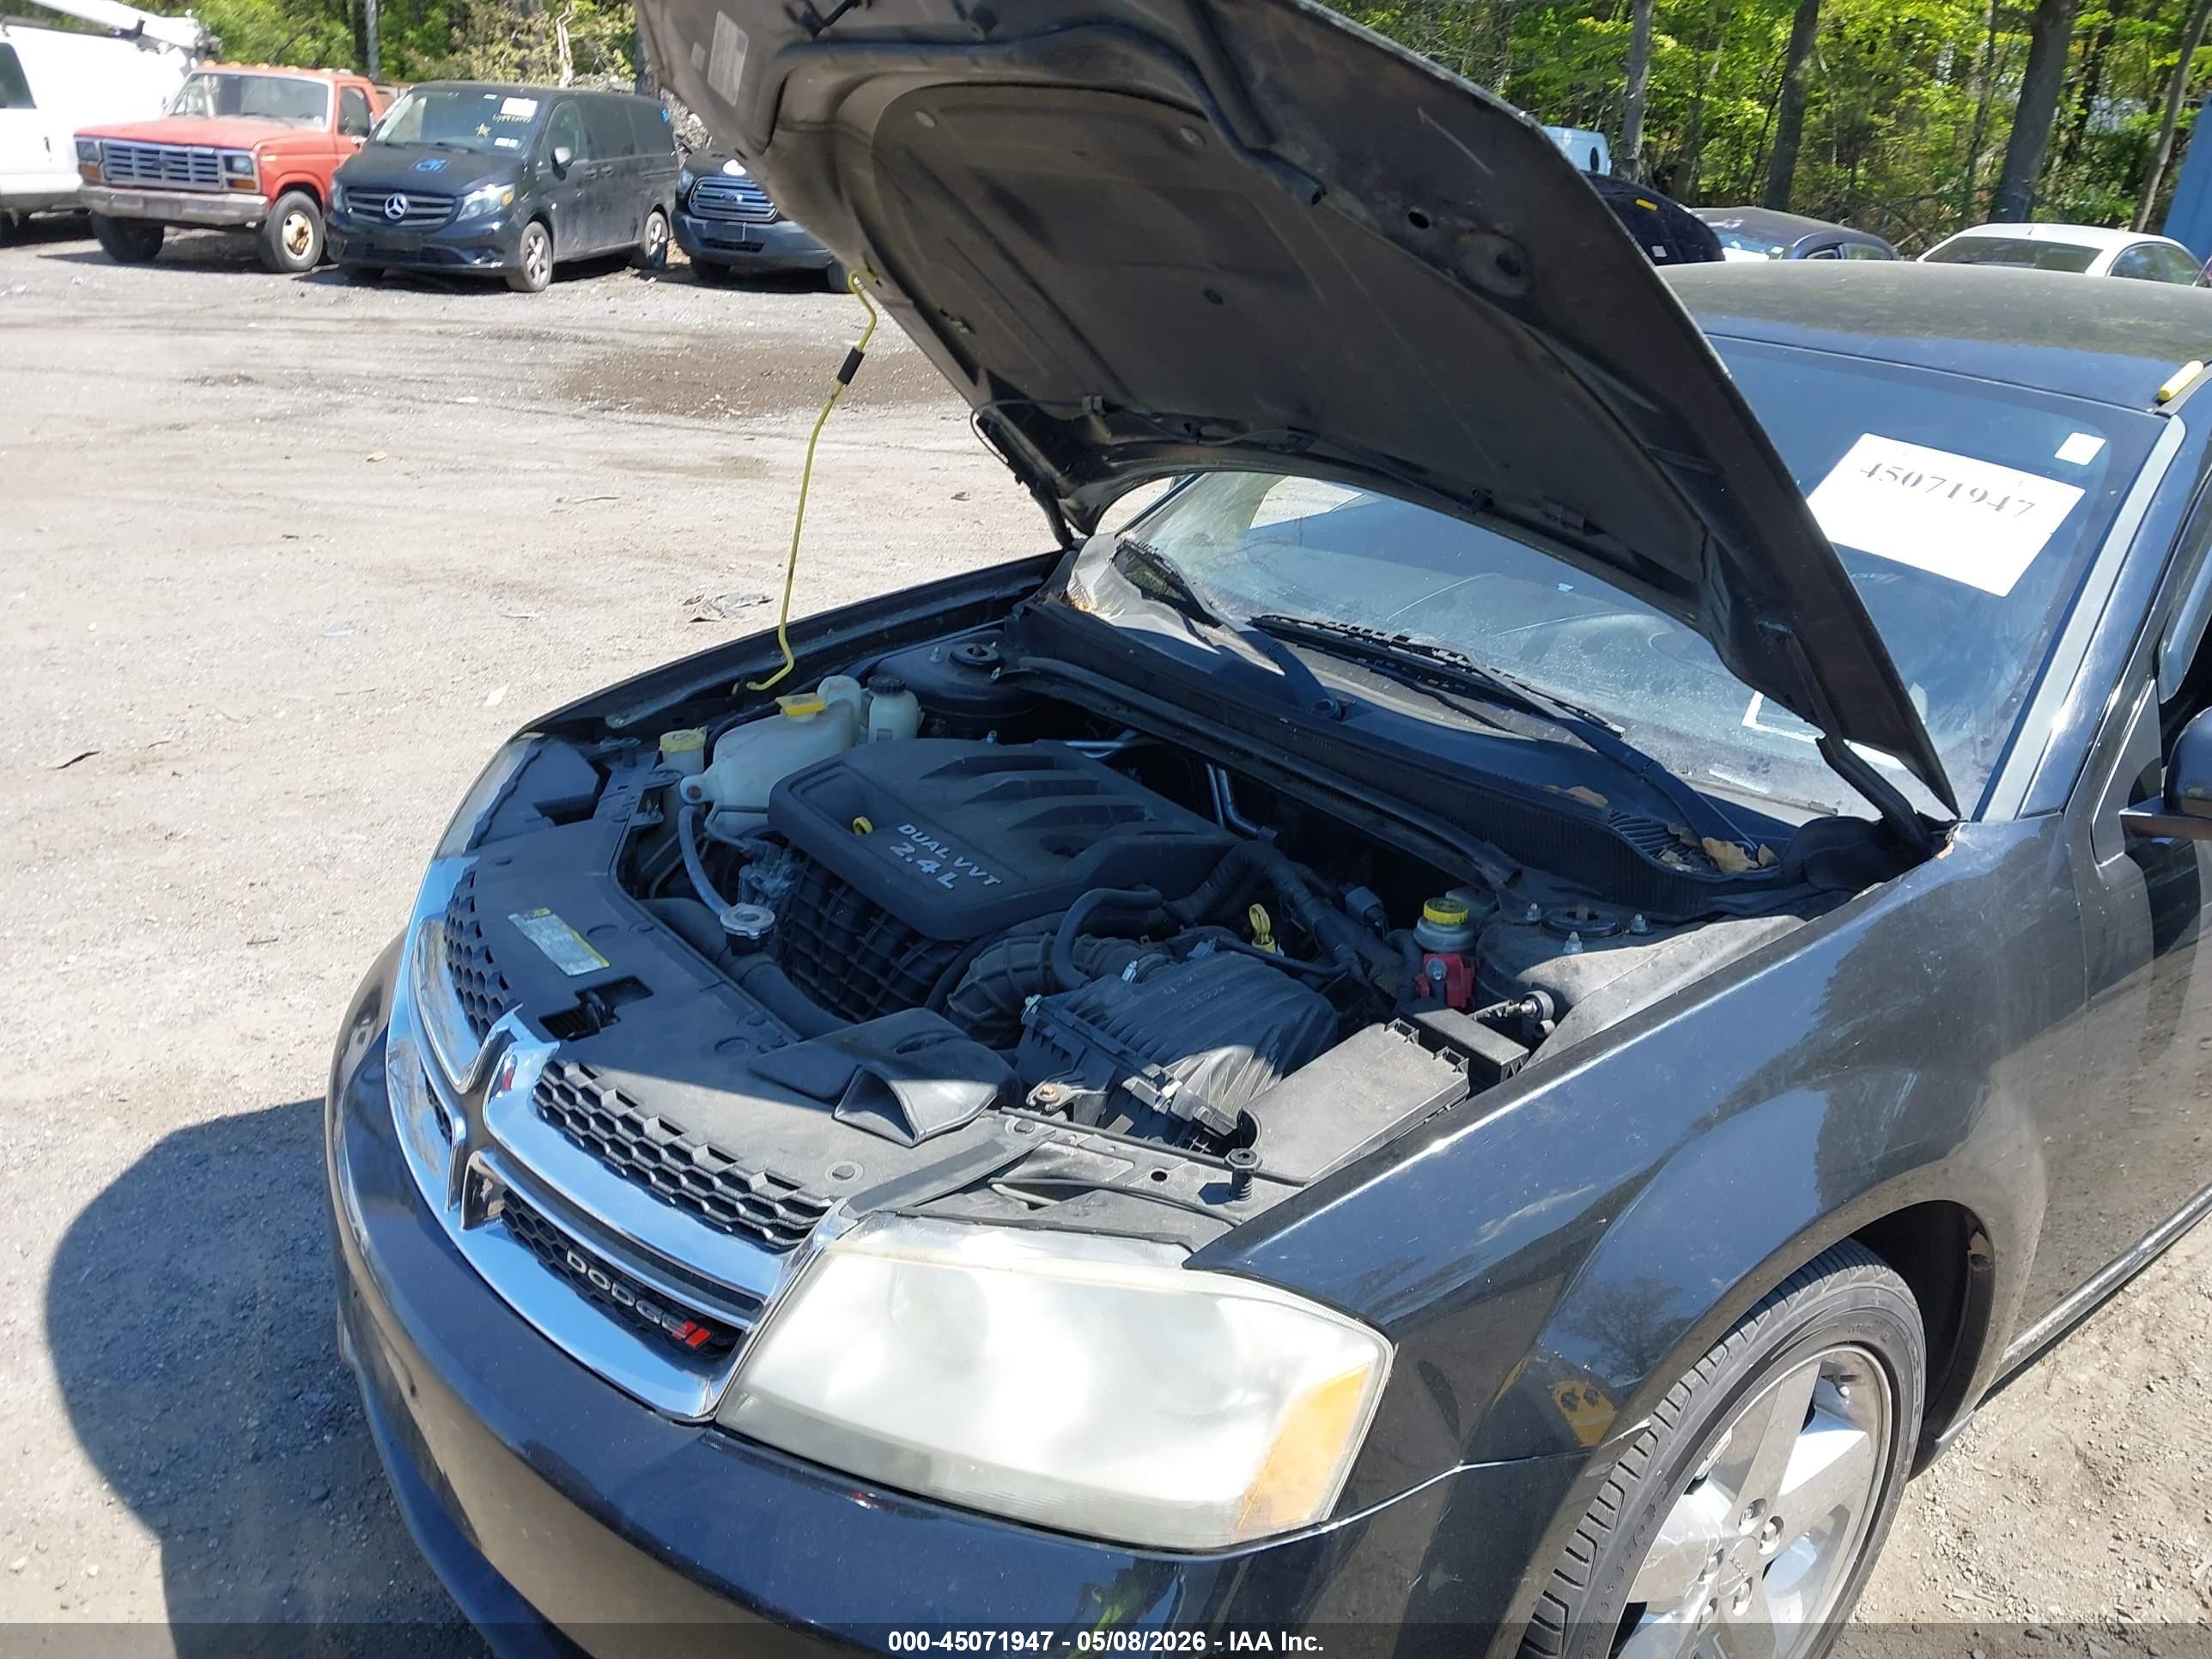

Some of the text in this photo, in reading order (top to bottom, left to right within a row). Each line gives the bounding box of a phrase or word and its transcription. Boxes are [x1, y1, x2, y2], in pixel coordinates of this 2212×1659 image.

[1859, 462, 2036, 519] 45071947
[896, 823, 1003, 887] DUAL VVT
[566, 1249, 690, 1340] DODGE
